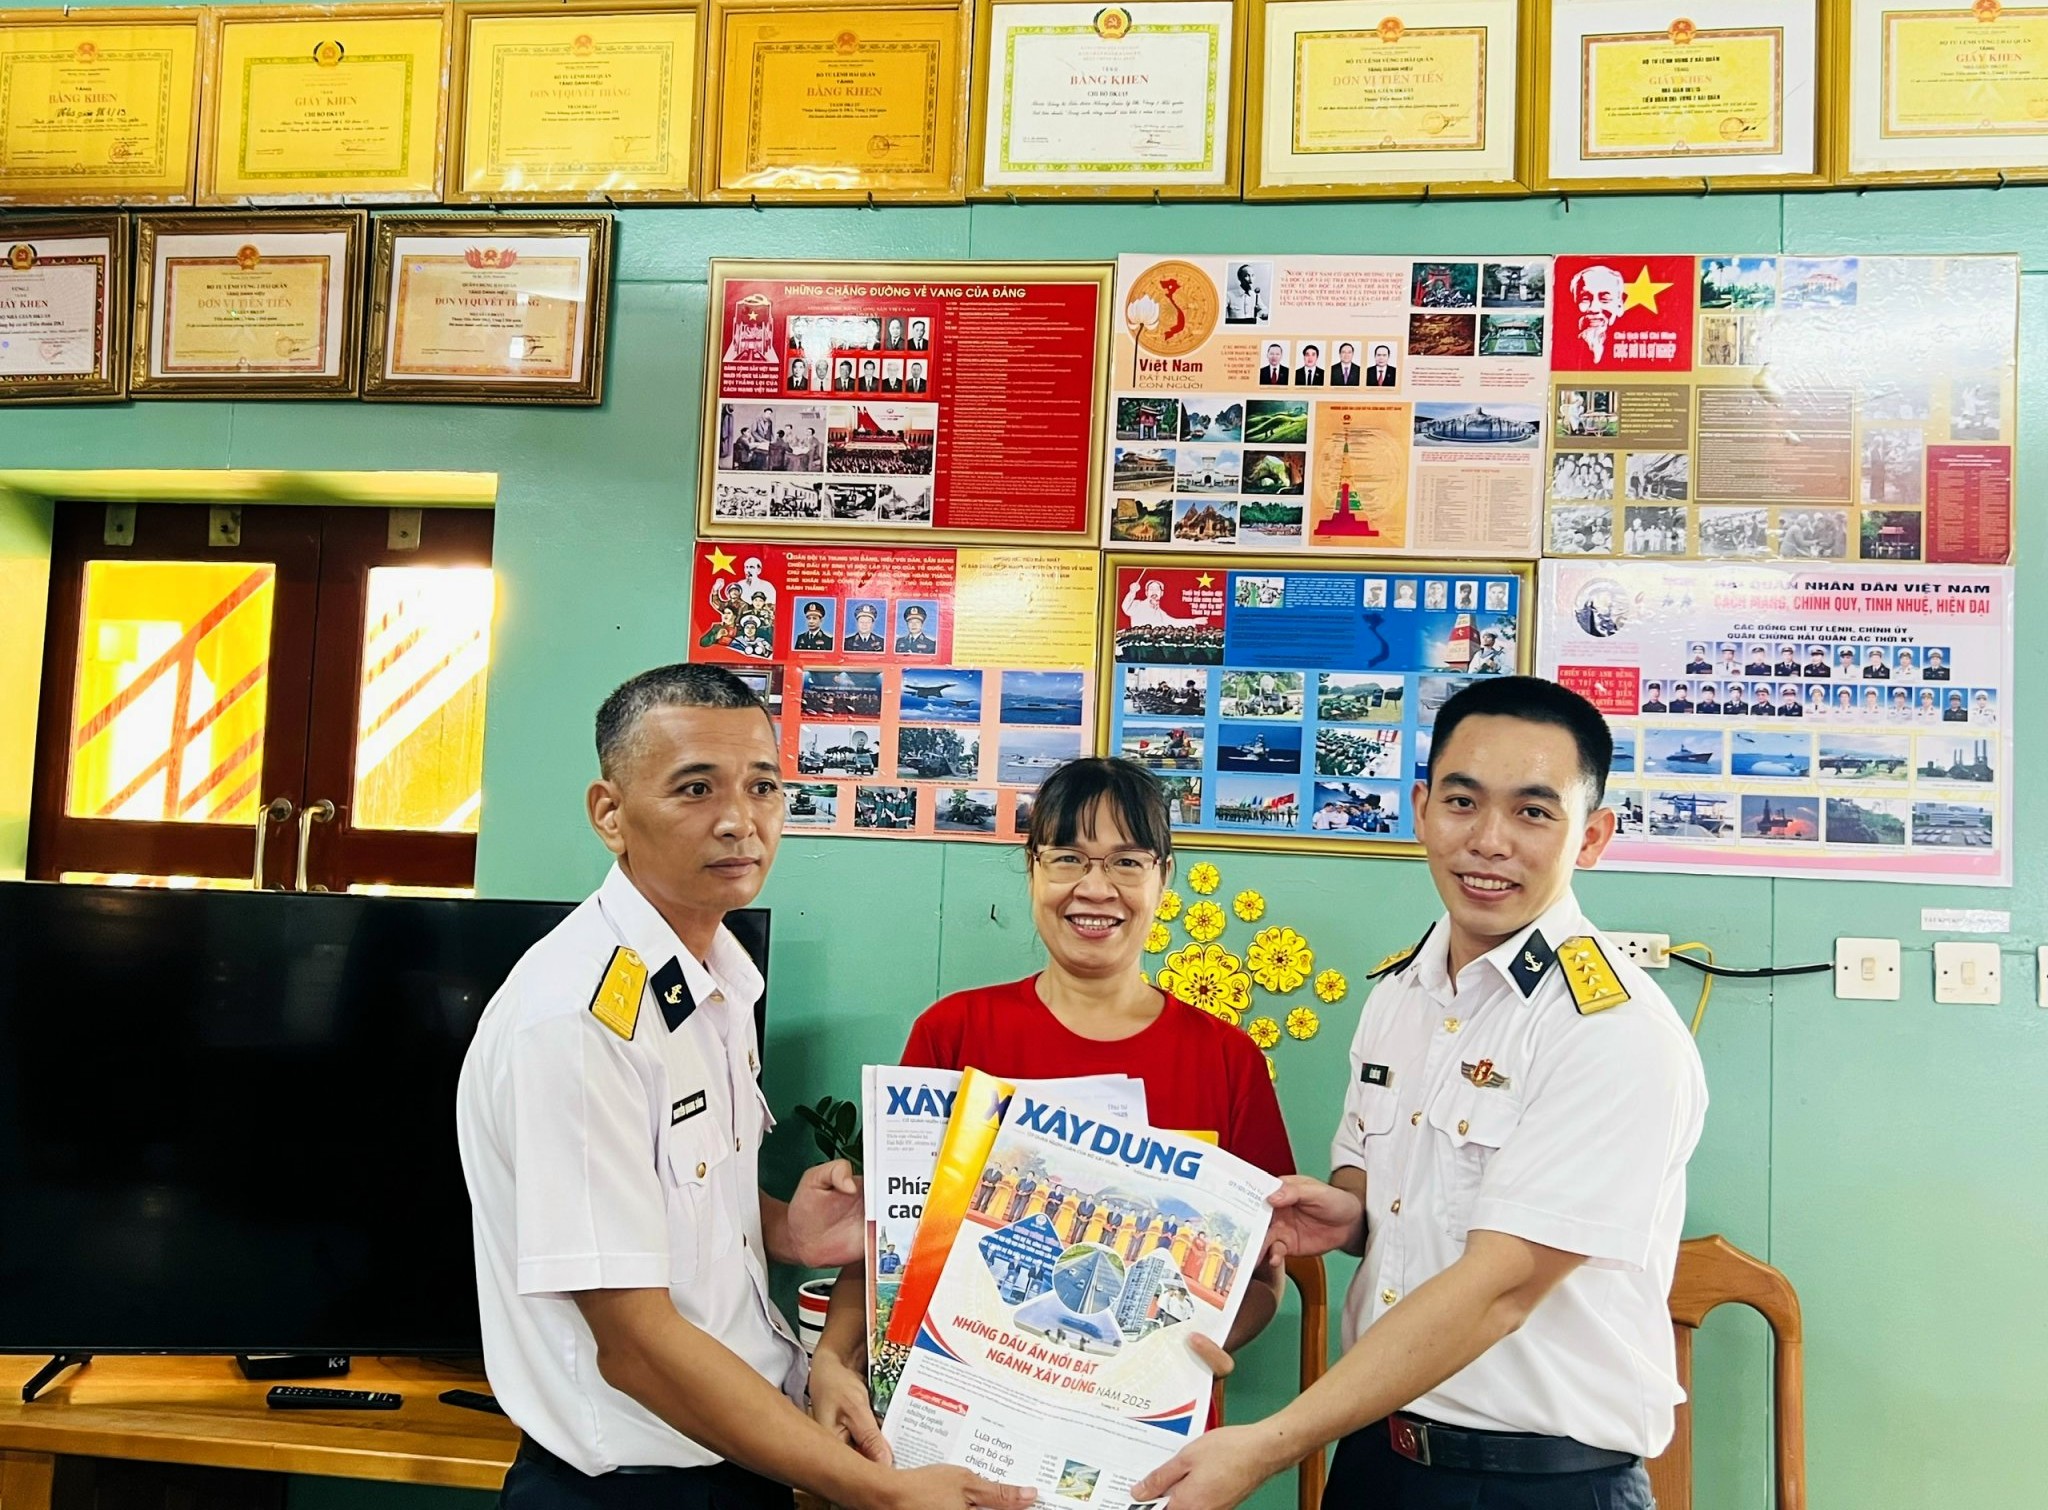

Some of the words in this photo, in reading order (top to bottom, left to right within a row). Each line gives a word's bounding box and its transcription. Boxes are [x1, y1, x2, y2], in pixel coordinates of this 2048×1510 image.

[784, 284, 824, 296] NHỮNG
[825, 284, 867, 298] CHẶNG
[869, 285, 911, 297] ĐƯỜNG
[914, 284, 927, 297] VẺ
[930, 287, 963, 297] VANG
[965, 285, 989, 298] CỦA
[992, 285, 1026, 298] ĐẢNG
[1139, 358, 1168, 373] Việt
[1172, 359, 1203, 372] Nam
[1804, 580, 1855, 591] NHÂN
[1861, 582, 1897, 592] DÂN
[1904, 583, 1941, 594] VIỆT
[1948, 585, 1990, 594] NAM
[1834, 597, 1861, 613] QUY,
[1865, 598, 1892, 611] TINH
[1896, 595, 1932, 616] NHUỆ,
[1936, 596, 1965, 616] HIỆN
[1969, 599, 1990, 617] ĐẠI
[888, 1176, 931, 1195] Phía
[888, 1204, 923, 1219] cao
[952, 1315, 998, 1341] NHỮNG
[999, 1332, 1027, 1352] DẤU
[1027, 1342, 1048, 1362] ẤN
[1049, 1351, 1072, 1370] NỔI
[1072, 1360, 1099, 1377] BẬT
[328, 1357, 346, 1368] K+
[986, 1347, 1033, 1376] NGÀNH
[1034, 1367, 1061, 1385] XÂY
[1062, 1375, 1097, 1394] DỰNG
[1096, 1385, 1122, 1401] NĂM
[1122, 1393, 1152, 1410] 2025
